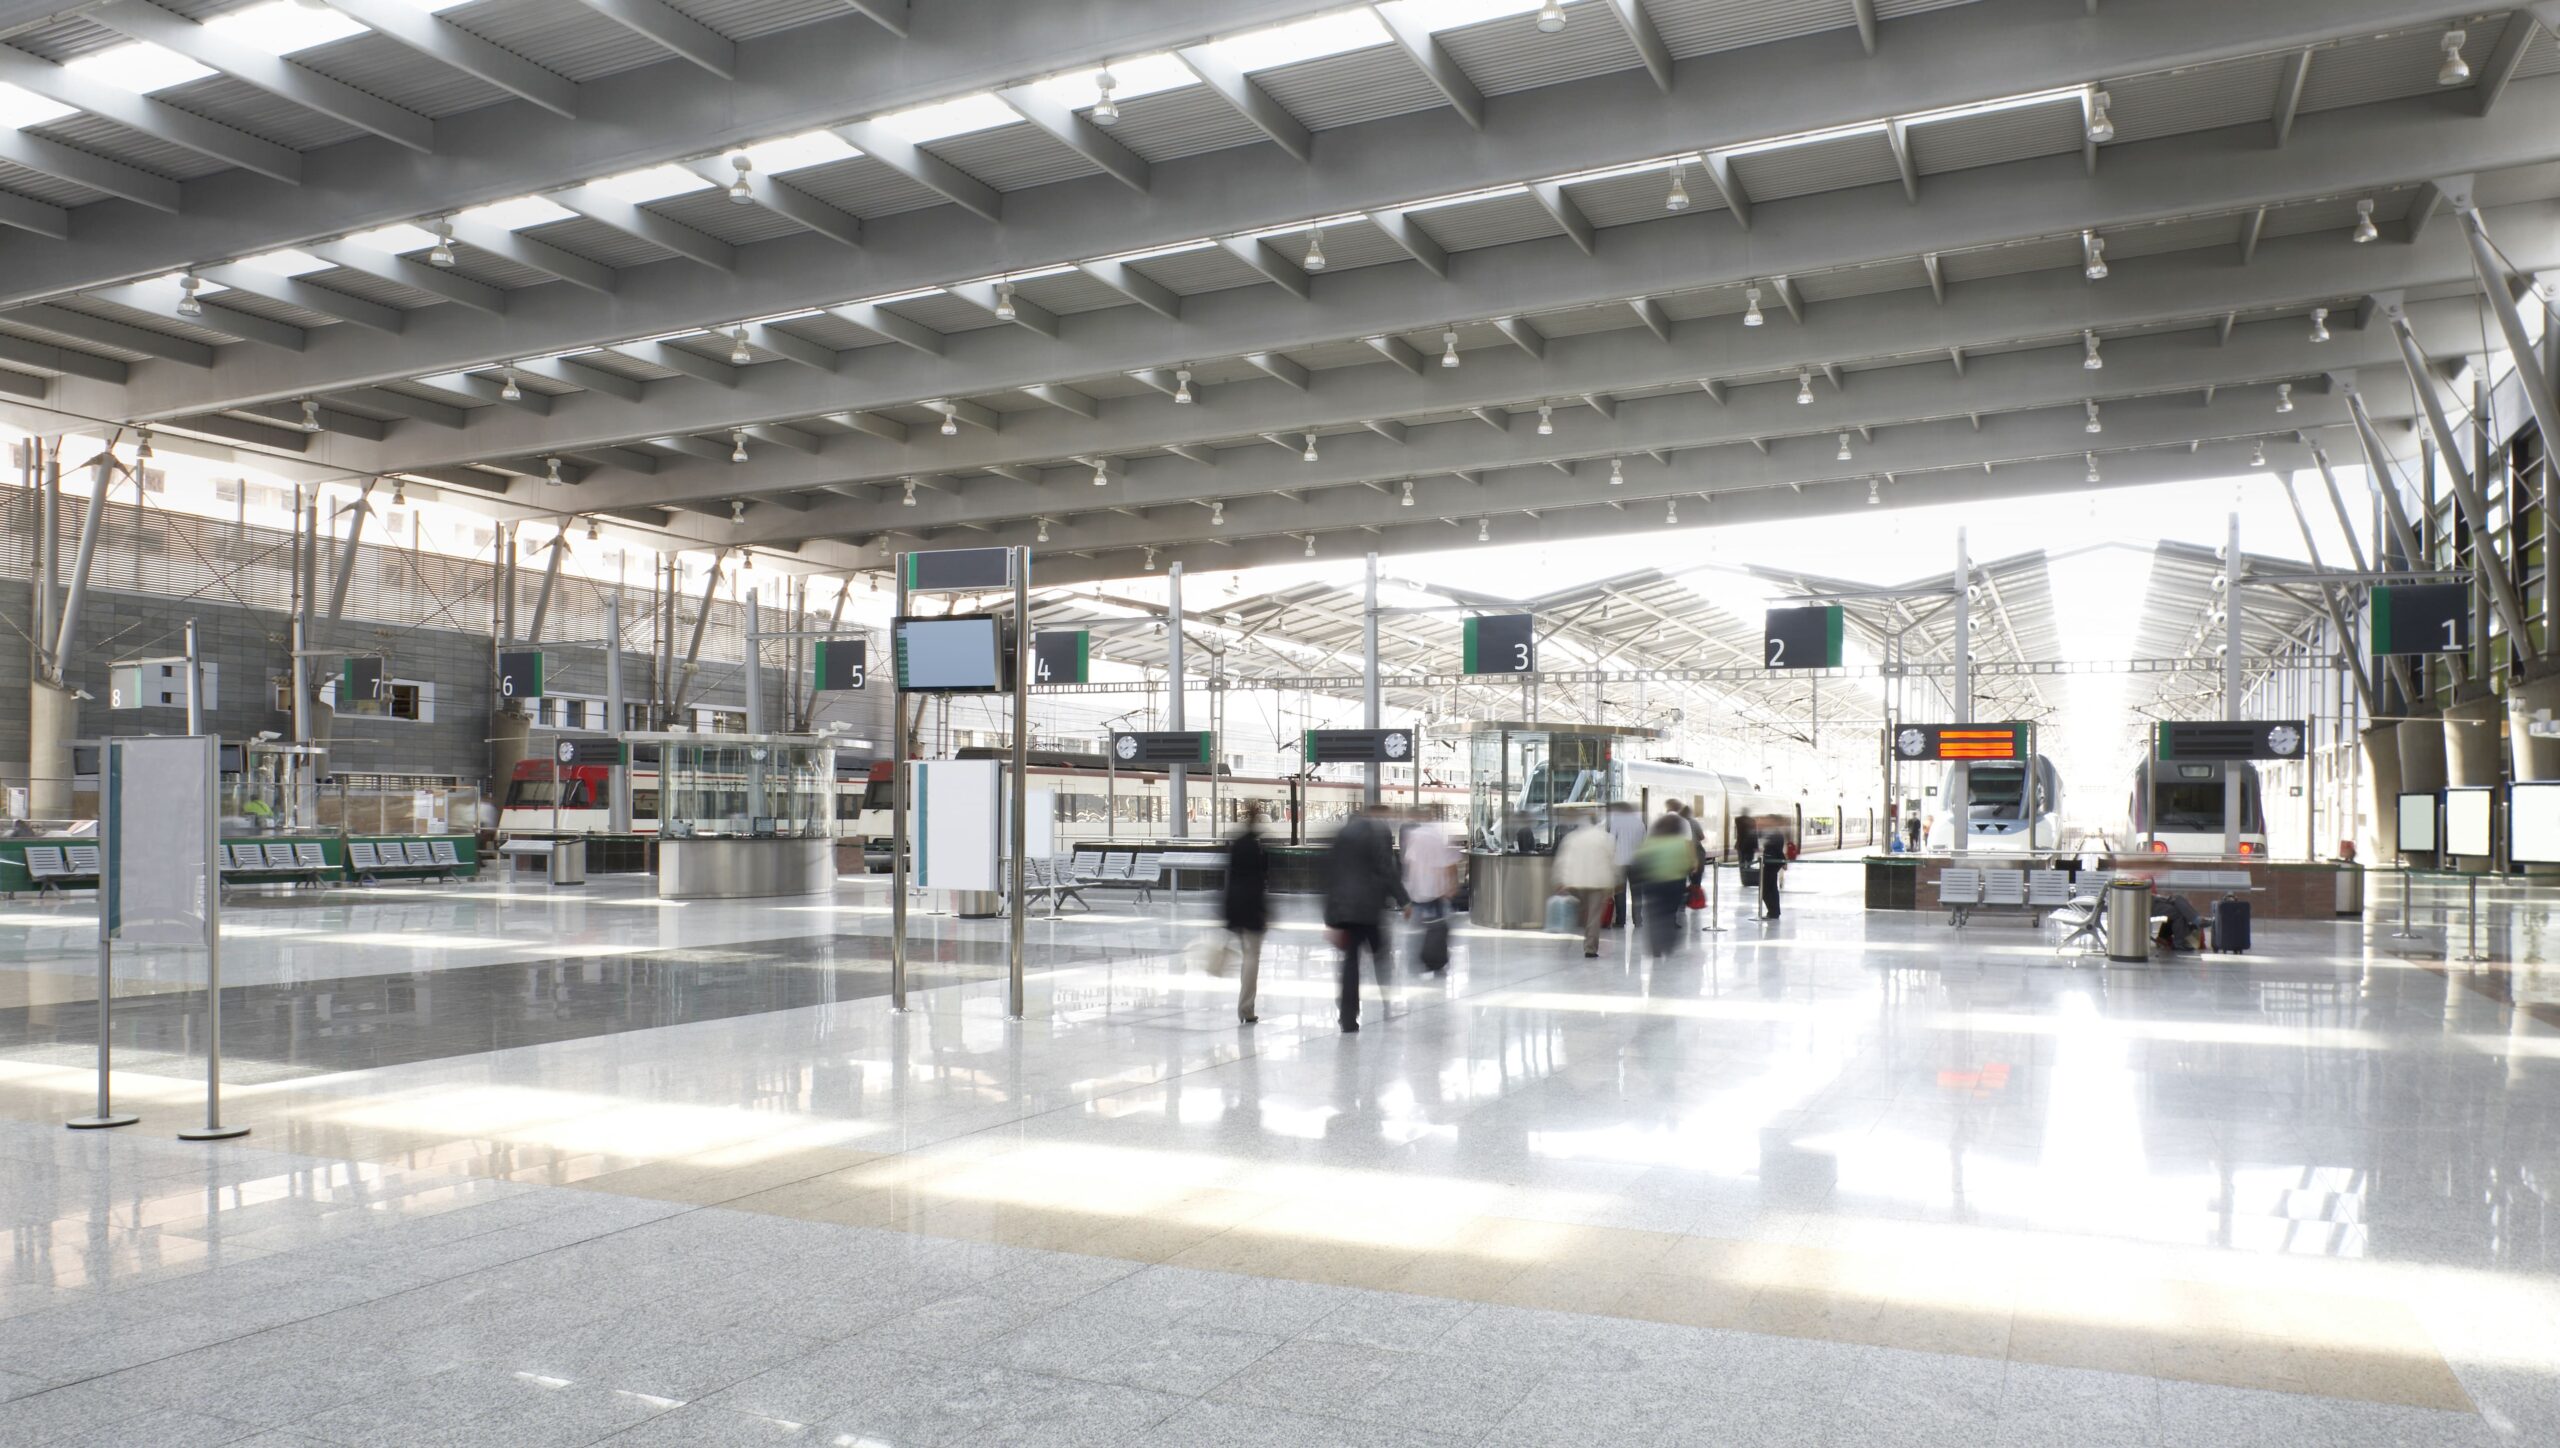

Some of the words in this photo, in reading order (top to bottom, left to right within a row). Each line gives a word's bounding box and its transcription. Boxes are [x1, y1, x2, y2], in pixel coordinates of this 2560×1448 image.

[2442, 619, 2463, 650] 1
[1514, 643, 1530, 670] 3
[1769, 639, 1785, 666] 2
[852, 665, 863, 687] 5
[1037, 658, 1051, 681] 4
[371, 679, 380, 698] 7
[503, 676, 513, 695] 6
[112, 689, 121, 707] 8
